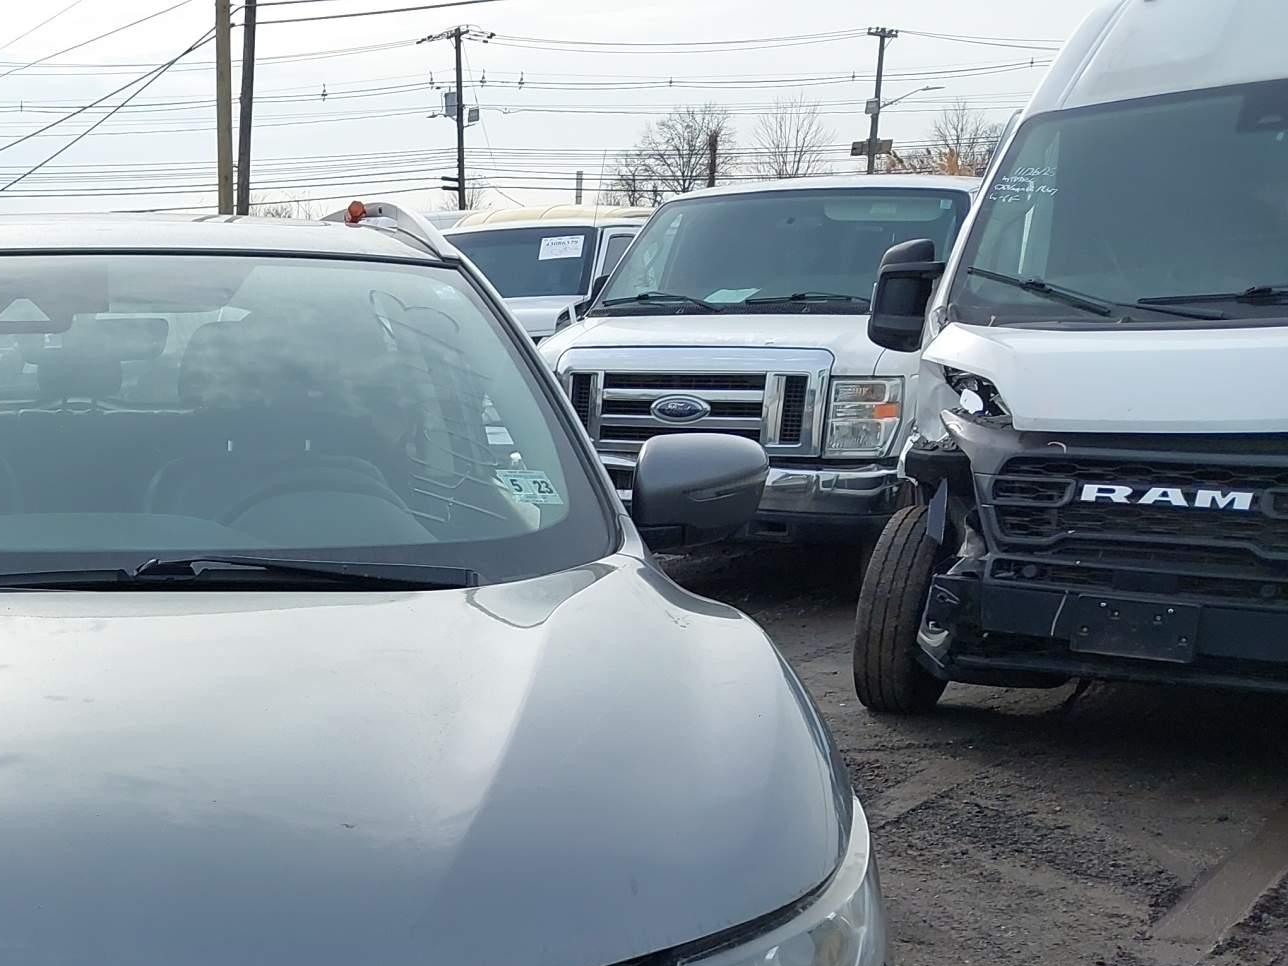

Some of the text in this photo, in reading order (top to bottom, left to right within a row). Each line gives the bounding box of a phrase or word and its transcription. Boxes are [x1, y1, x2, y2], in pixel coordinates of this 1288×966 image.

[509, 478, 554, 495] 5 23
[1080, 483, 1254, 510] RAM
